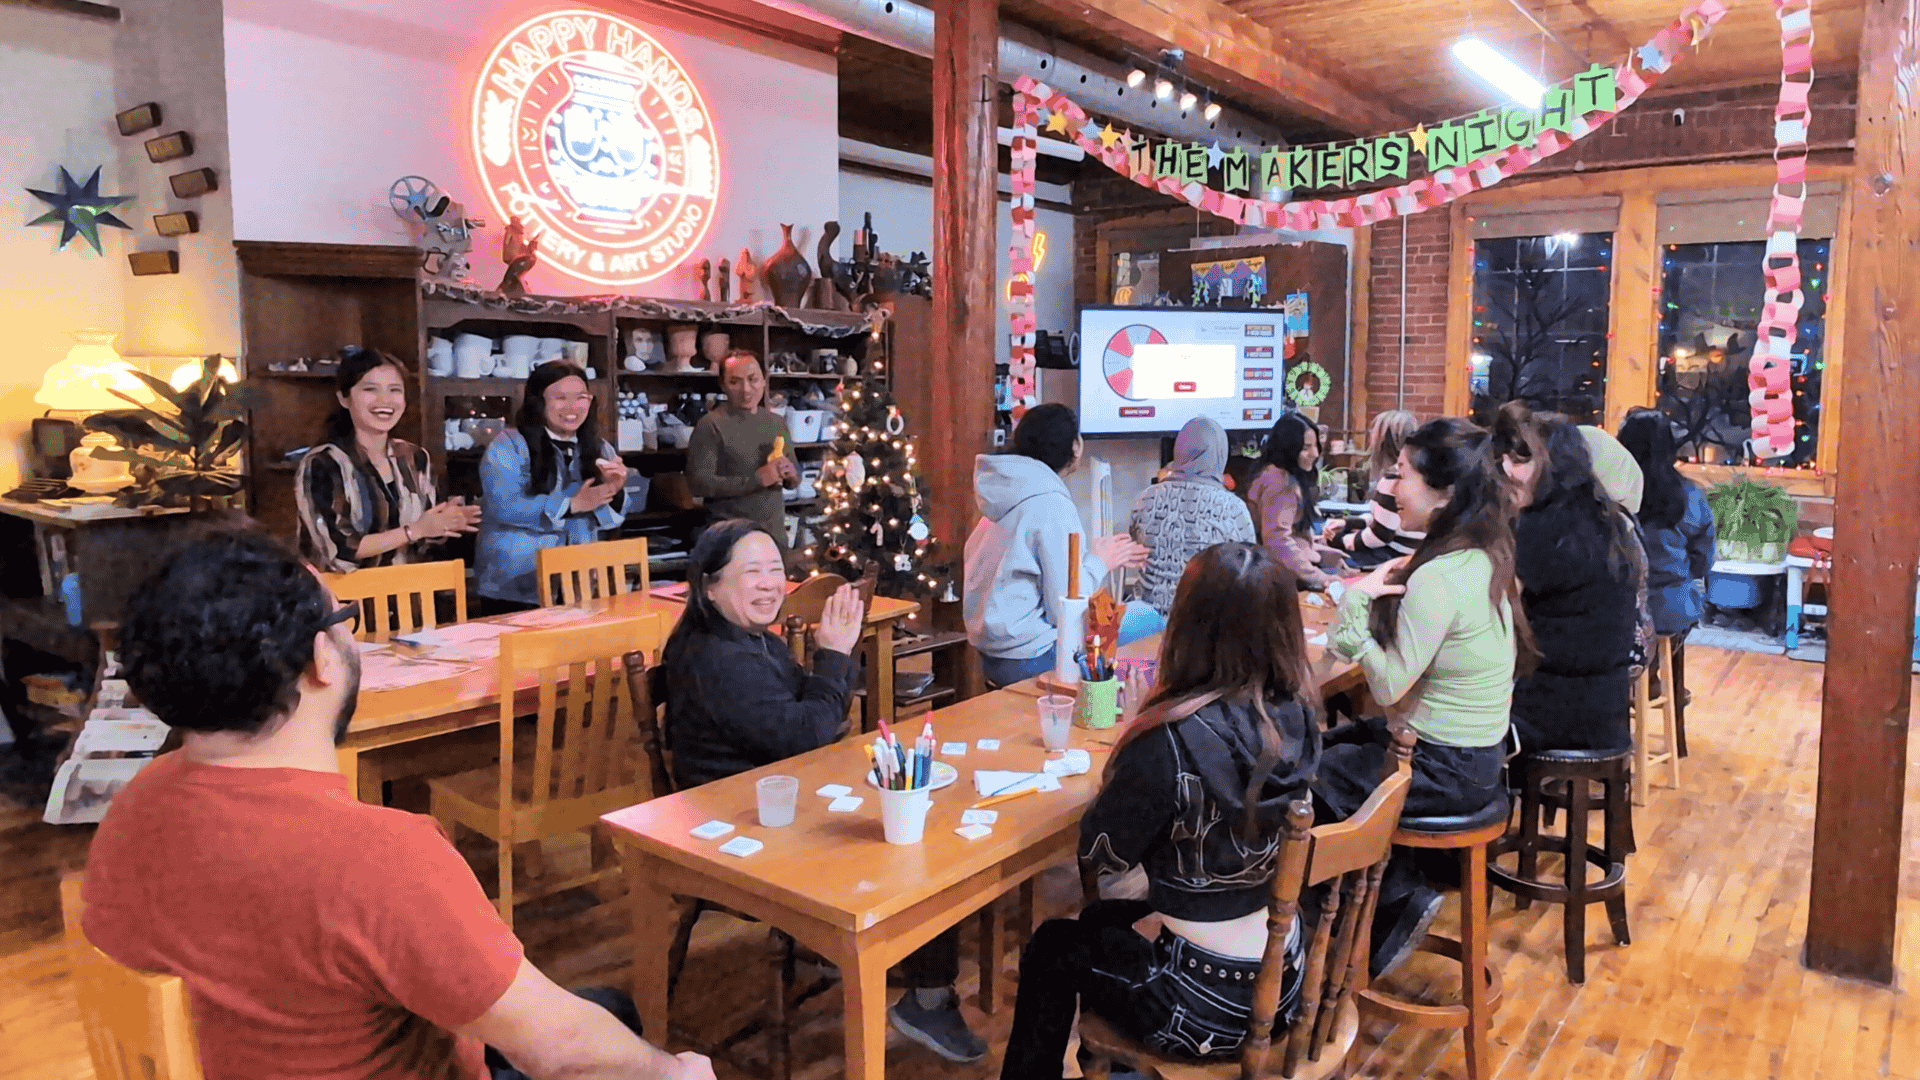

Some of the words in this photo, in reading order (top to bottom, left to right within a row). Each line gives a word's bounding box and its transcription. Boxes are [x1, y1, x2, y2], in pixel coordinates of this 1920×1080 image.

[491, 16, 597, 98] HAPPY
[606, 22, 704, 134] HANDS
[1131, 142, 1204, 178] THE
[1226, 141, 1403, 187] MAKERS
[1434, 73, 1610, 165] NIGHT
[499, 181, 587, 265] POTTERY
[588, 251, 605, 272] &
[608, 251, 649, 273] ART
[649, 204, 703, 264] STUDIO
